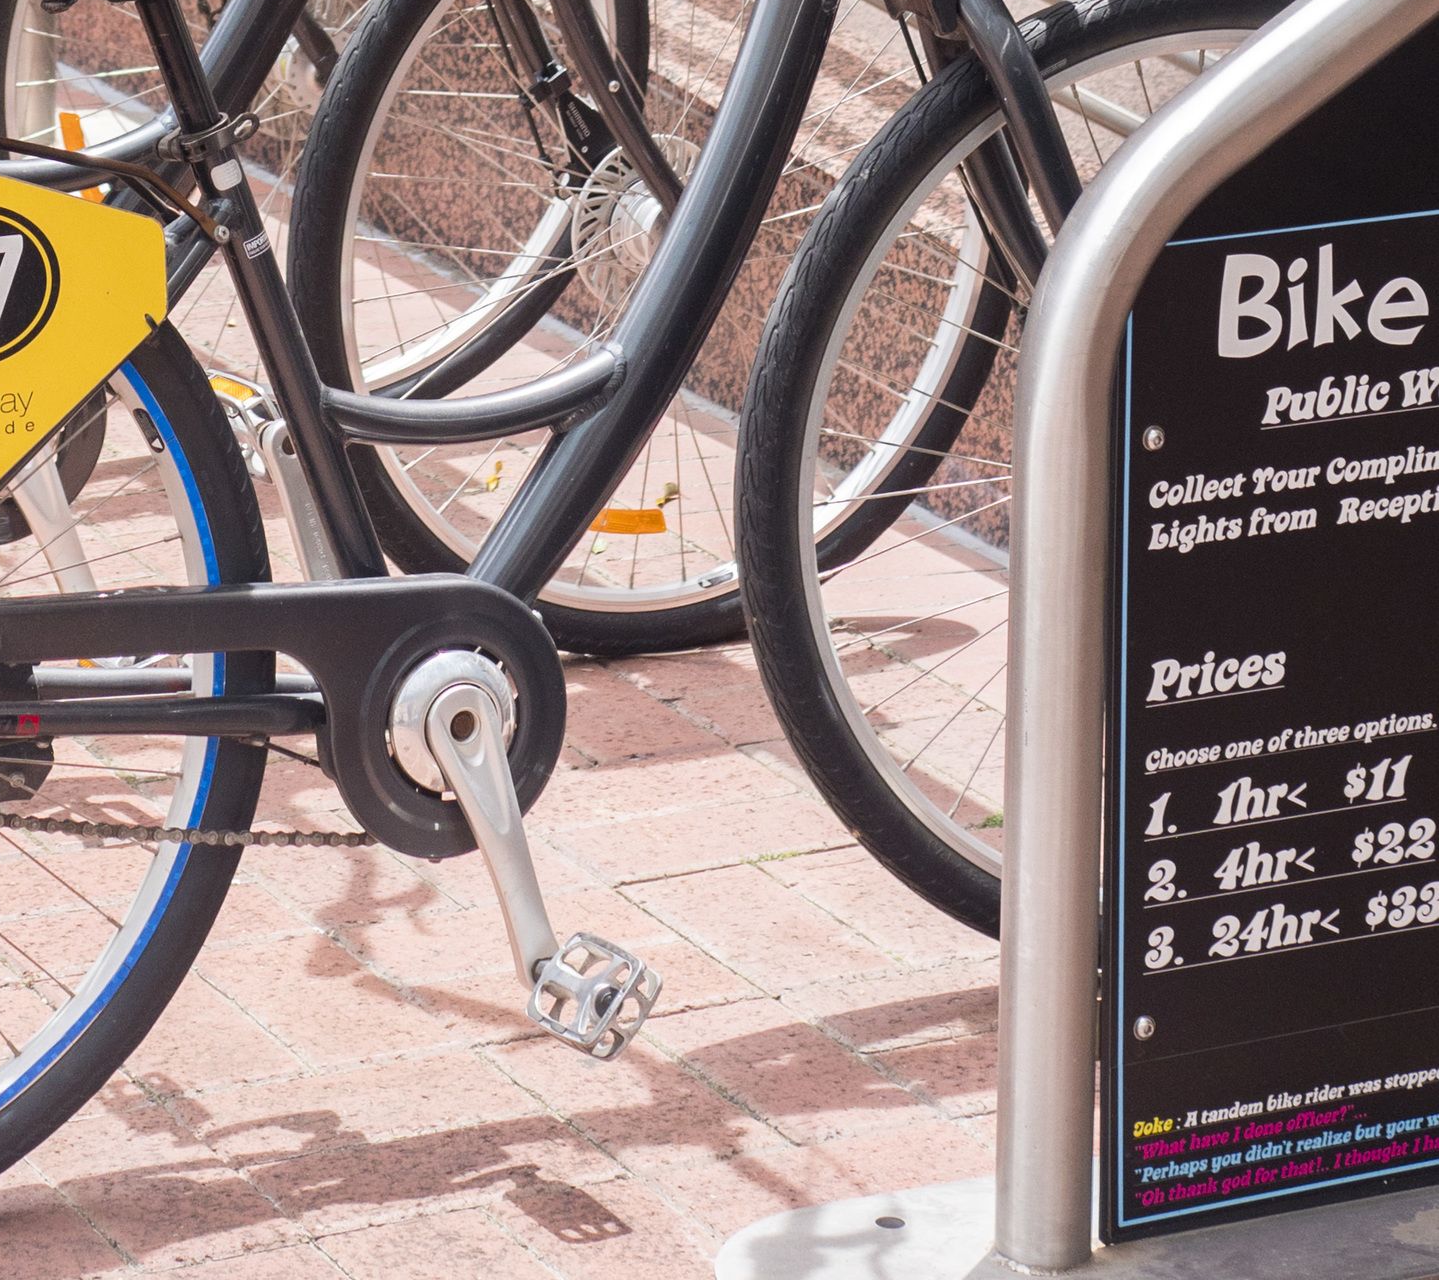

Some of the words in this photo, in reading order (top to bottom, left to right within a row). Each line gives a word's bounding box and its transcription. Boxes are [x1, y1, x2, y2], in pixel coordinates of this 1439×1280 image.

[1218, 243, 1430, 359] Bike
[1261, 374, 1389, 426] Public
[1149, 474, 1246, 508] Collect
[1252, 465, 1320, 494] Your
[1148, 515, 1241, 554] Lights
[1248, 506, 1317, 537] from
[1145, 651, 1286, 702] Prices
[1145, 744, 1220, 772] Choose
[1225, 739, 1262, 759] one
[1268, 728, 1293, 751] of
[1294, 726, 1350, 749] three
[1353, 713, 1437, 743] options.
[1144, 792, 1177, 836] 1.
[1344, 754, 1412, 804] $11
[1144, 859, 1187, 902] 2.
[1352, 817, 1436, 868] $22
[1144, 926, 1183, 969] 3.
[1365, 881, 1439, 932] $33
[1133, 1116, 1173, 1137] Joke
[1184, 1111, 1198, 1128] A
[1201, 1099, 1263, 1125] tandem
[1266, 1093, 1302, 1112] bike
[1305, 1083, 1344, 1105] rider
[1349, 1077, 1381, 1096] was
[1189, 1130, 1229, 1151] have
[1233, 1126, 1241, 1143] I
[1244, 1121, 1283, 1141] done
[1168, 1177, 1217, 1201] thank
[1222, 1172, 1251, 1195] god
[1254, 1166, 1277, 1186] for
[1333, 1153, 1342, 1170] I
[1344, 1140, 1408, 1167] thought
[1412, 1137, 1420, 1153] I
[1211, 1152, 1241, 1173] you
[1245, 1140, 1292, 1162] didn't
[1296, 1129, 1352, 1151] realize
[1355, 1123, 1382, 1141] but
[1386, 1117, 1424, 1139] your
